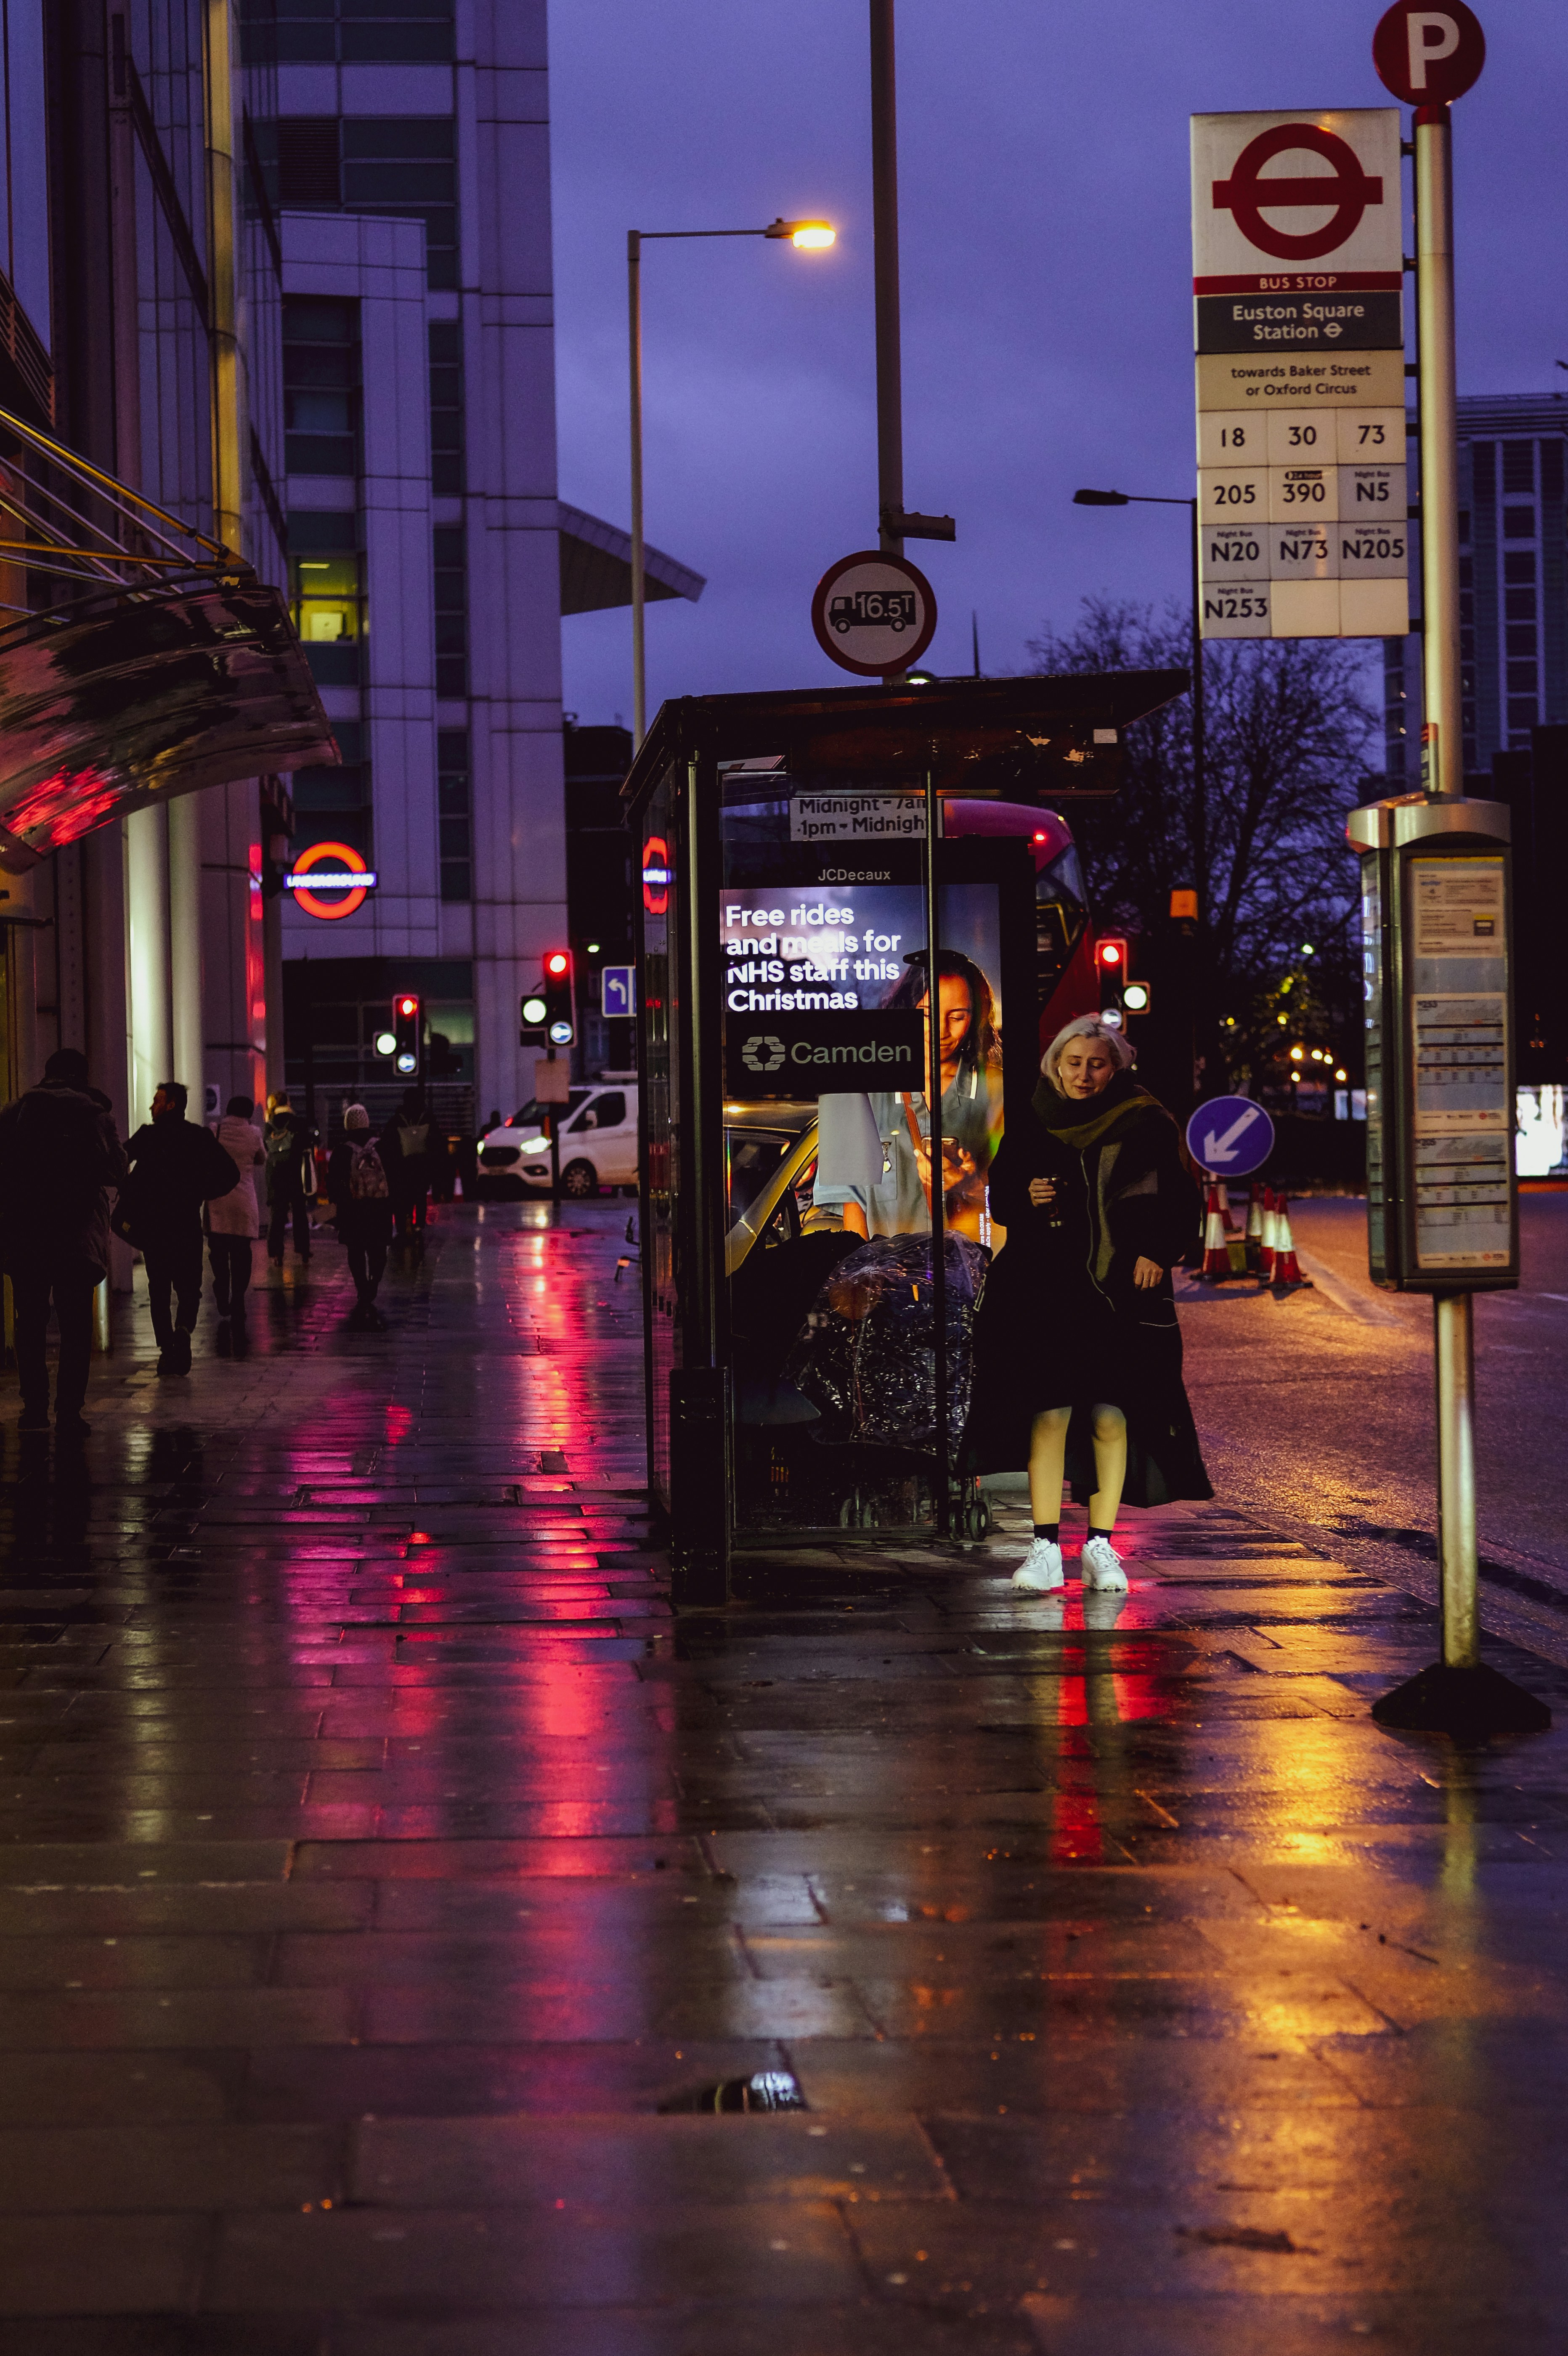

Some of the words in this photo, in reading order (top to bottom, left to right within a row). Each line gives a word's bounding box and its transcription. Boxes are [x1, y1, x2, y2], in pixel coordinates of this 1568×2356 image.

[1406, 12, 1459, 89] P
[1259, 277, 1291, 289] BUS
[1296, 276, 1337, 288] STOP
[1233, 304, 1297, 321] Euston
[1303, 303, 1365, 322] Square
[1253, 324, 1319, 340] Station
[1231, 367, 1286, 379] towards
[1290, 366, 1327, 377] Baker
[1331, 364, 1371, 376] Street
[1246, 386, 1260, 397] or
[1264, 384, 1312, 396] Oxford
[1316, 382, 1357, 394] Circus
[1222, 428, 1245, 447] 18
[1288, 426, 1317, 445] 30
[1358, 425, 1385, 444] 73
[1213, 484, 1255, 505] 205
[1283, 483, 1325, 503] 390
[1356, 482, 1389, 502] N5
[1211, 541, 1260, 562] N20
[1280, 540, 1328, 560] N73
[1342, 539, 1404, 559] N205
[1205, 598, 1268, 619] N253
[800, 799, 879, 815] Midnight
[852, 815, 926, 834] Midnigh
[818, 869, 891, 881] JCDecaux
[726, 905, 785, 927] Free
[790, 903, 854, 925] rides
[727, 934, 777, 956] and
[782, 931, 859, 954] meals
[863, 930, 901, 952] for
[727, 961, 784, 983] NHS
[790, 959, 849, 982] staff
[853, 958, 900, 980] this
[727, 990, 859, 1012] Christmas
[791, 1041, 911, 1063] Camden
